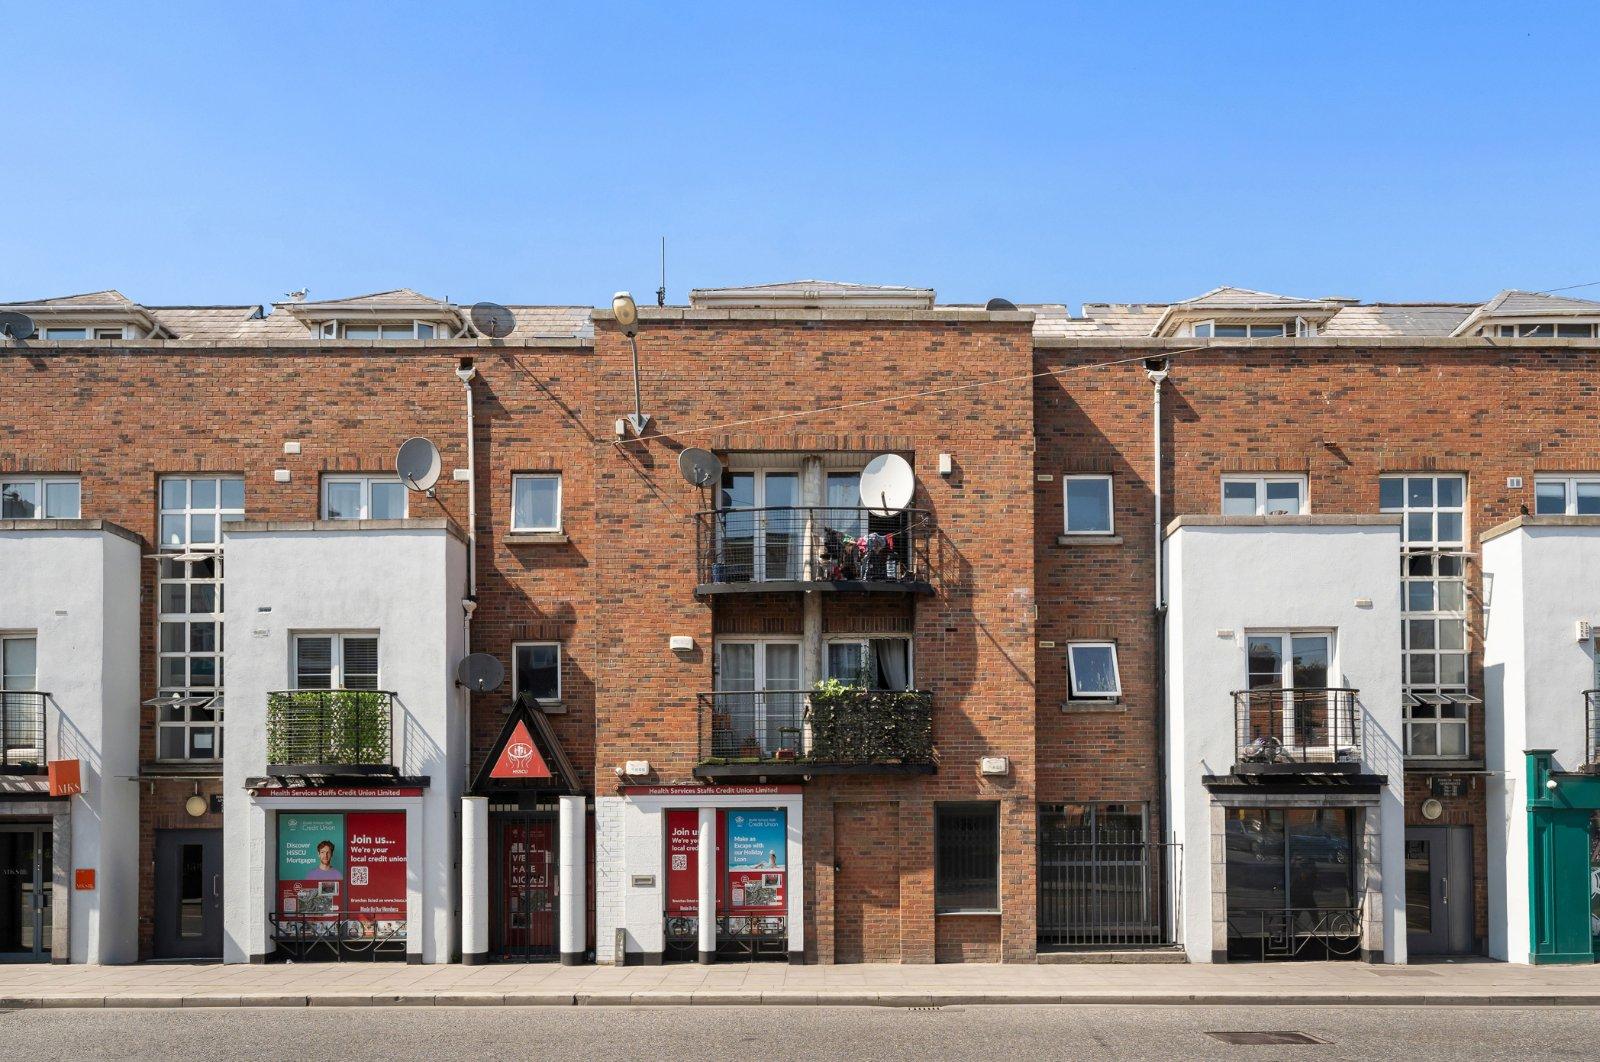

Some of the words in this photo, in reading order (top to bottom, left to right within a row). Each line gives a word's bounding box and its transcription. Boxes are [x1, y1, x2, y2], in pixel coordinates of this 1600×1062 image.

[58, 783, 80, 794] MKS
[270, 789, 291, 797] Health
[292, 789, 317, 797] Services
[318, 789, 336, 797] Staffs
[337, 789, 356, 797] Credit
[359, 789, 376, 797] Union
[377, 789, 400, 797] Limited
[672, 828, 690, 836] Join
[350, 834, 372, 844] Join
[372, 847, 388, 855] your
[286, 857, 316, 865] Mortgages
[512, 865, 536, 873] HAE
